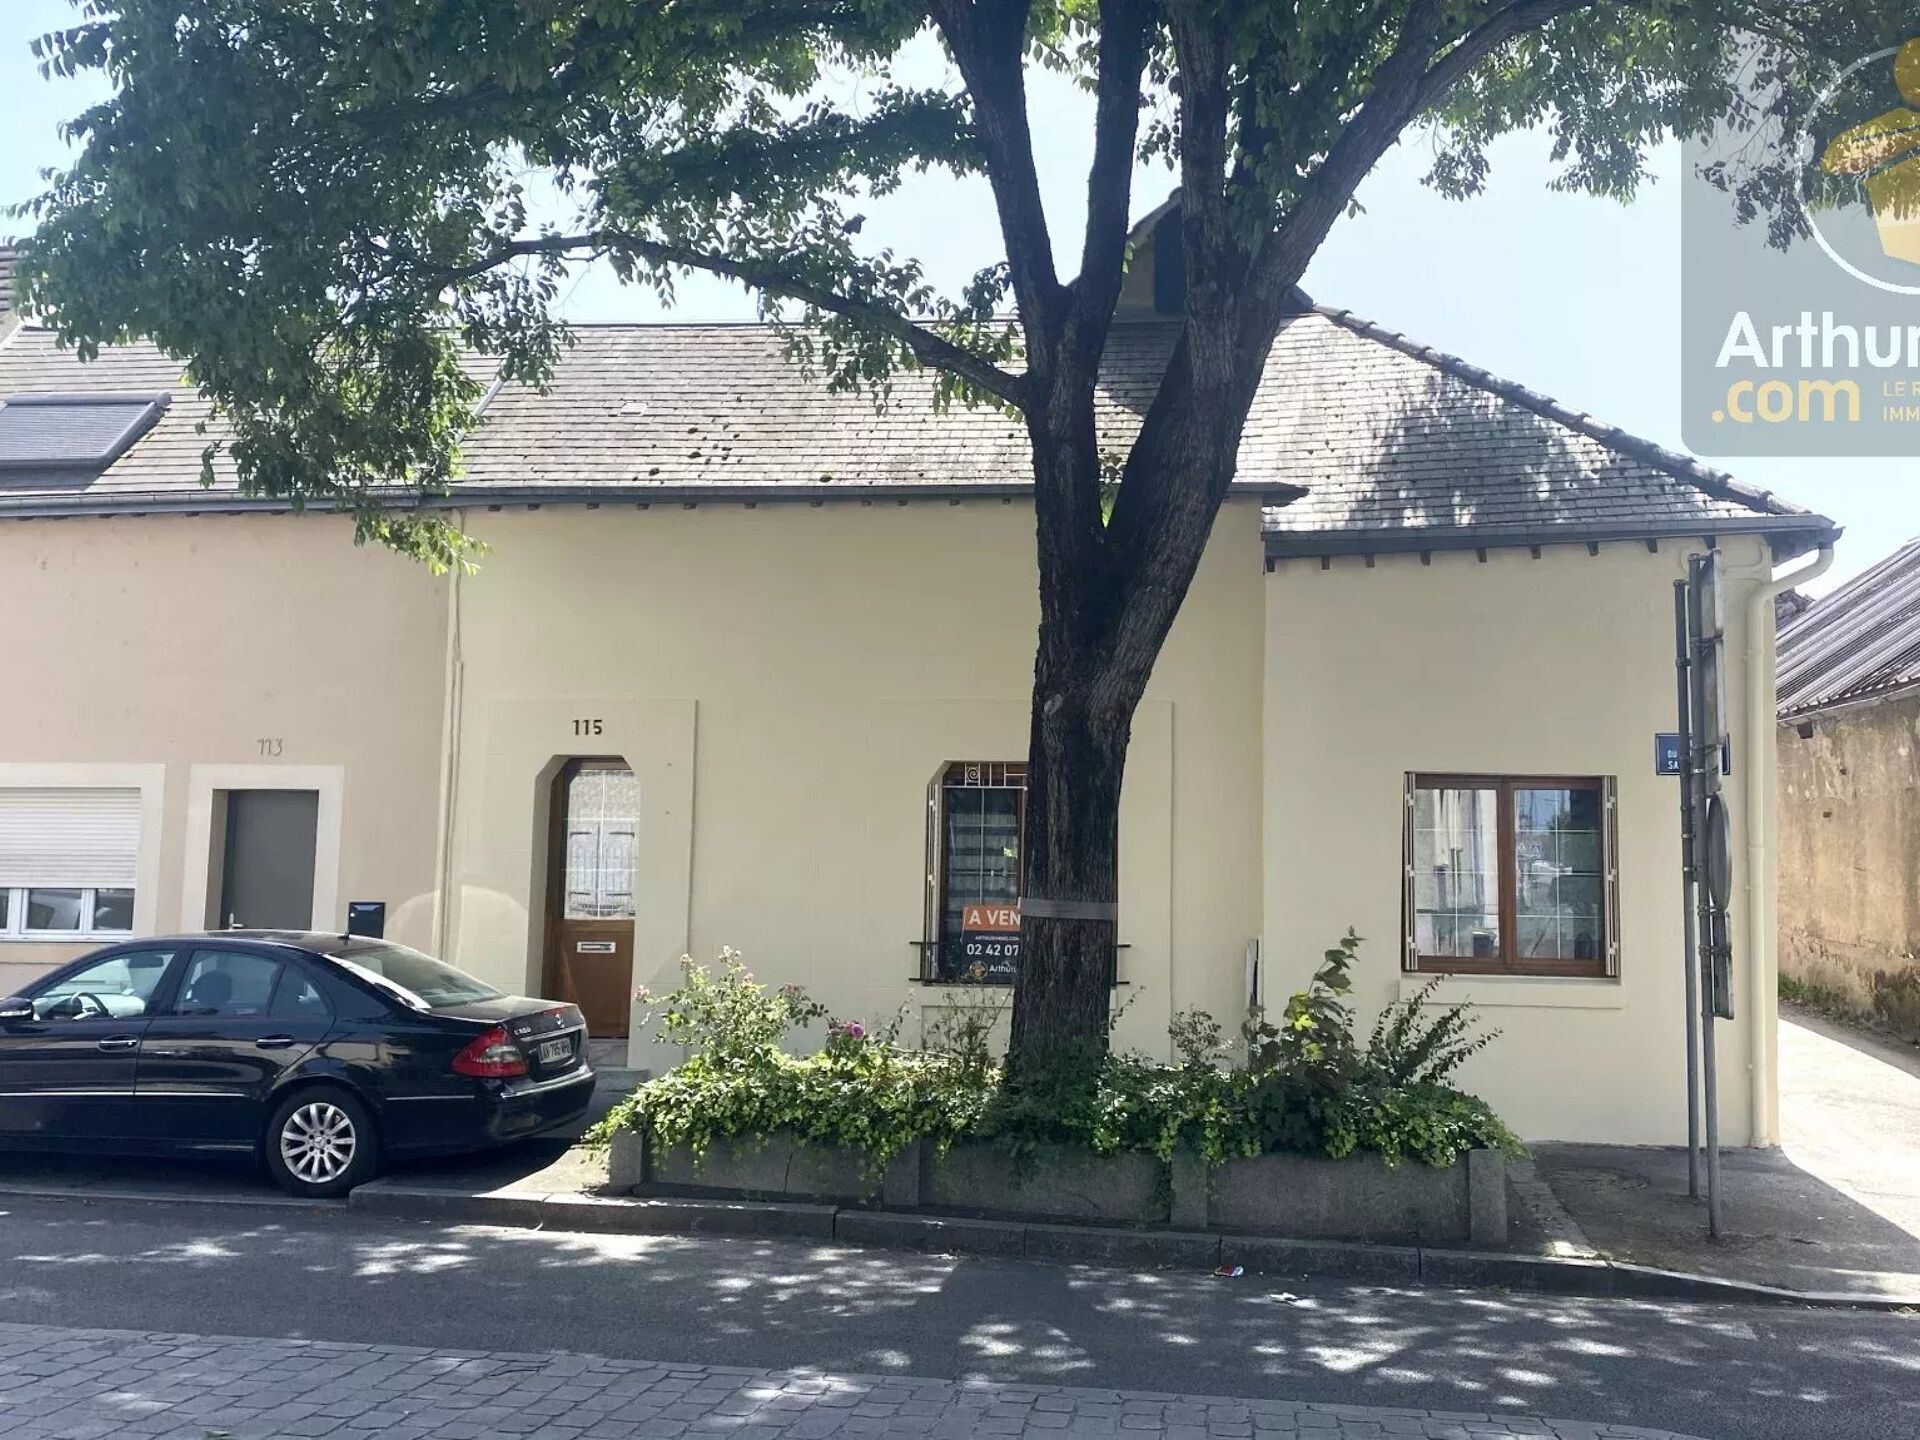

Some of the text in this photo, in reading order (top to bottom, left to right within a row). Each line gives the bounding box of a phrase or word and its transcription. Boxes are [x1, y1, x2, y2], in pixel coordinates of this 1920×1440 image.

[571, 719, 603, 736] 115
[256, 738, 283, 757] 113
[969, 910, 1020, 926] A VEN
[967, 944, 1019, 957] 02 42 07
